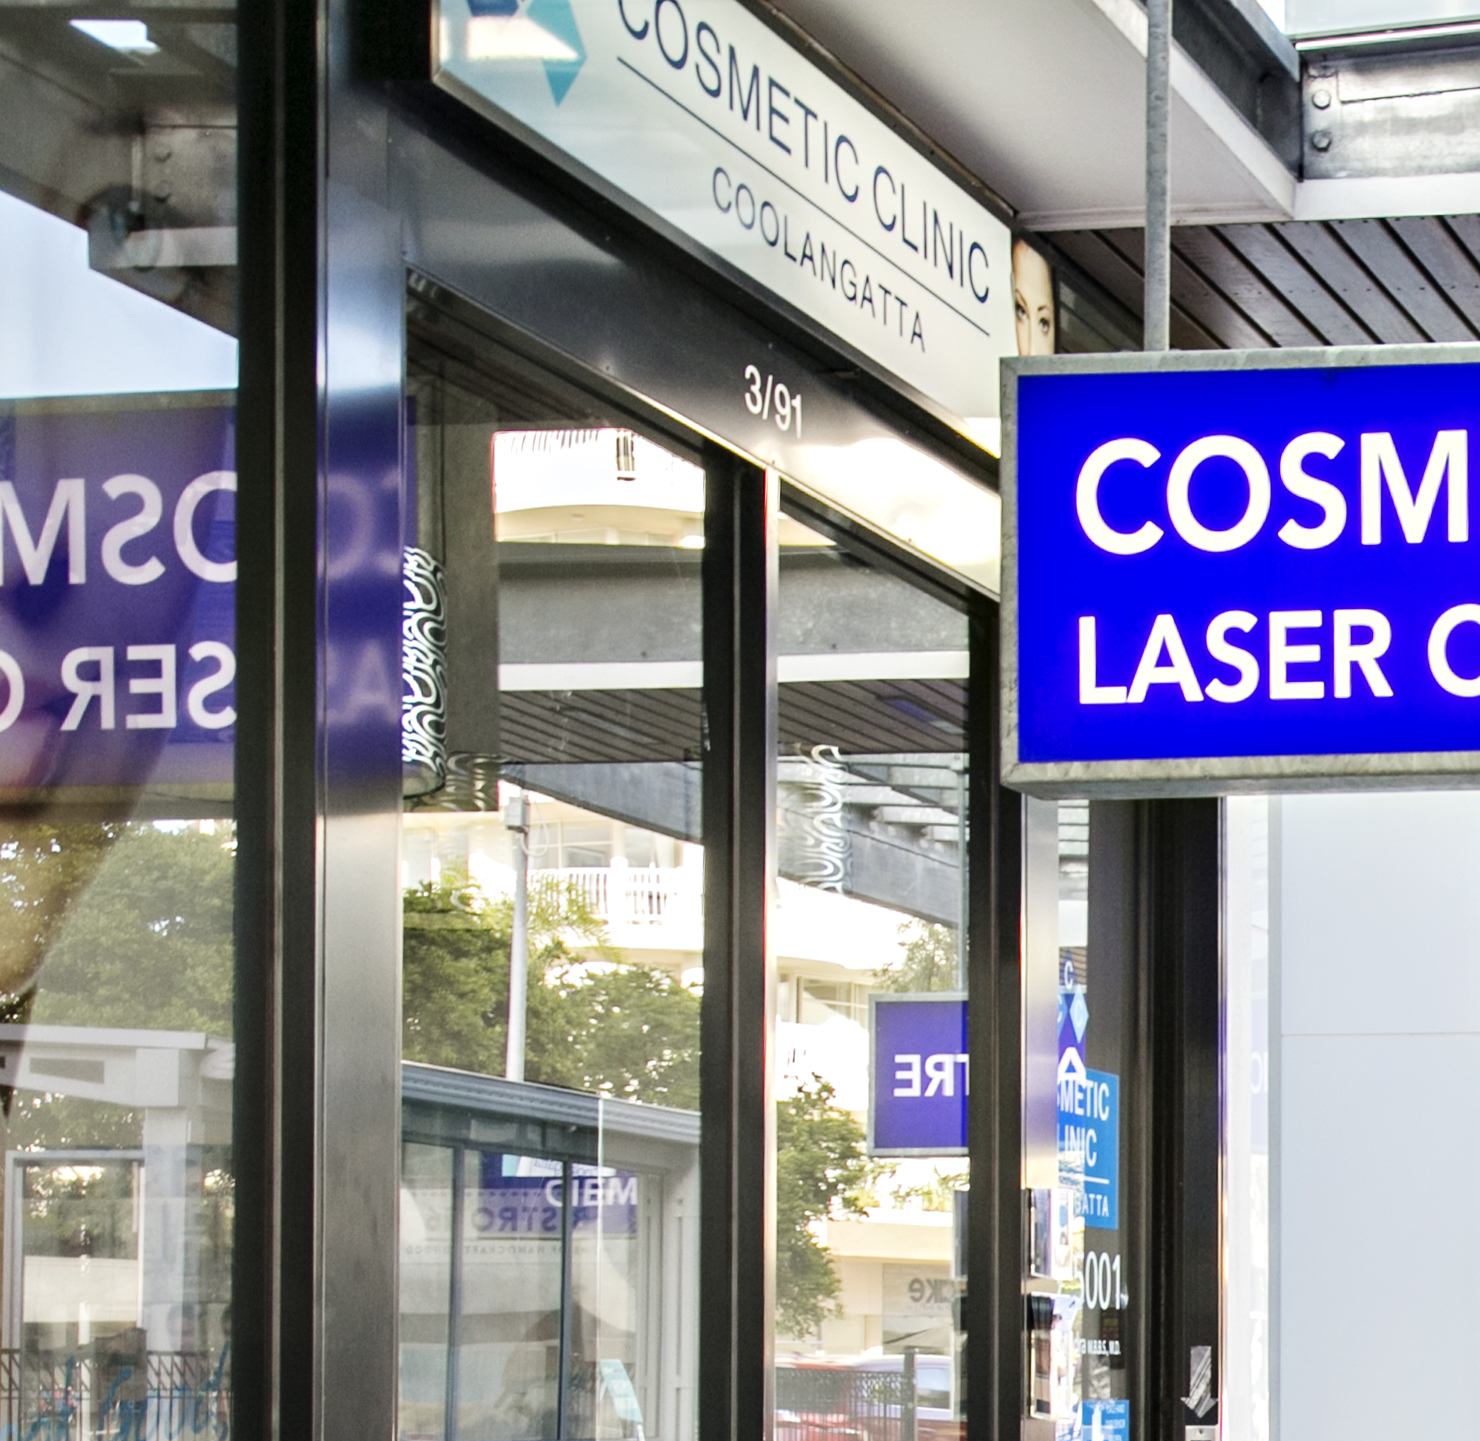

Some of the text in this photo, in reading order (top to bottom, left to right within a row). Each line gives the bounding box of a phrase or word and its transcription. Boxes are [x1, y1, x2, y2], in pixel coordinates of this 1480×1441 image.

[618, 0, 989, 304] COSMETIC CLINIC
[712, 166, 925, 353] COOLANGATTA
[744, 363, 803, 440] 3/91
[1076, 606, 1394, 706] LASER
